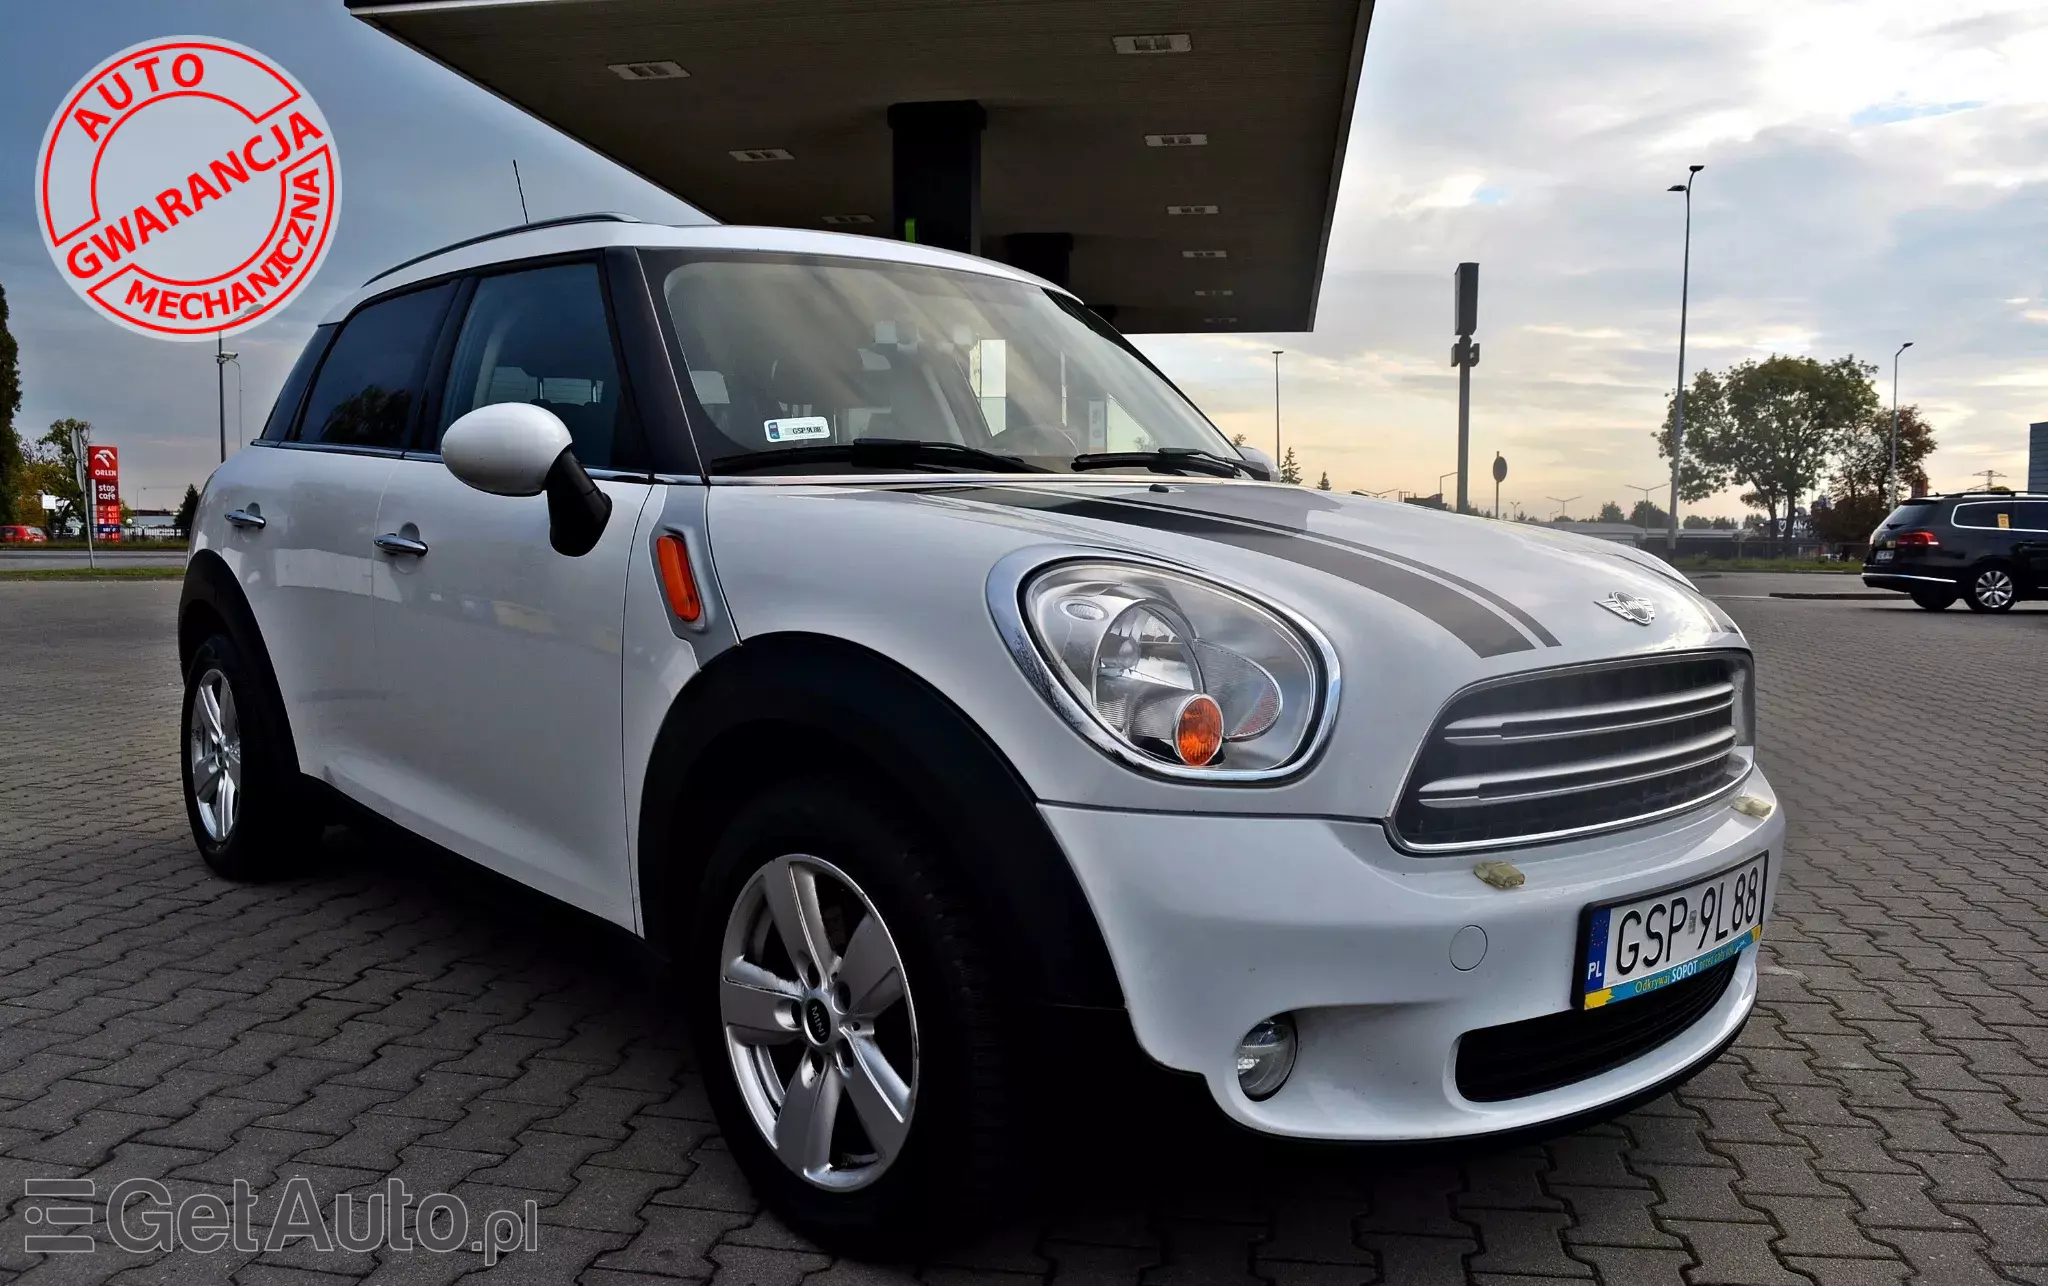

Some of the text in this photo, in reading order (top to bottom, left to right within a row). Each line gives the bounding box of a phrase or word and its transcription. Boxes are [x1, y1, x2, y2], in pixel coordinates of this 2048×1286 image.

[98, 484, 116, 492] stop
[98, 492, 116, 500] cafe
[1616, 866, 1759, 976] GSP 9L88
[1587, 960, 1603, 980] PL
[1635, 974, 1670, 994] Odkrywaj
[1671, 960, 1699, 982] SOPOT
[811, 1005, 826, 1036] MINI
